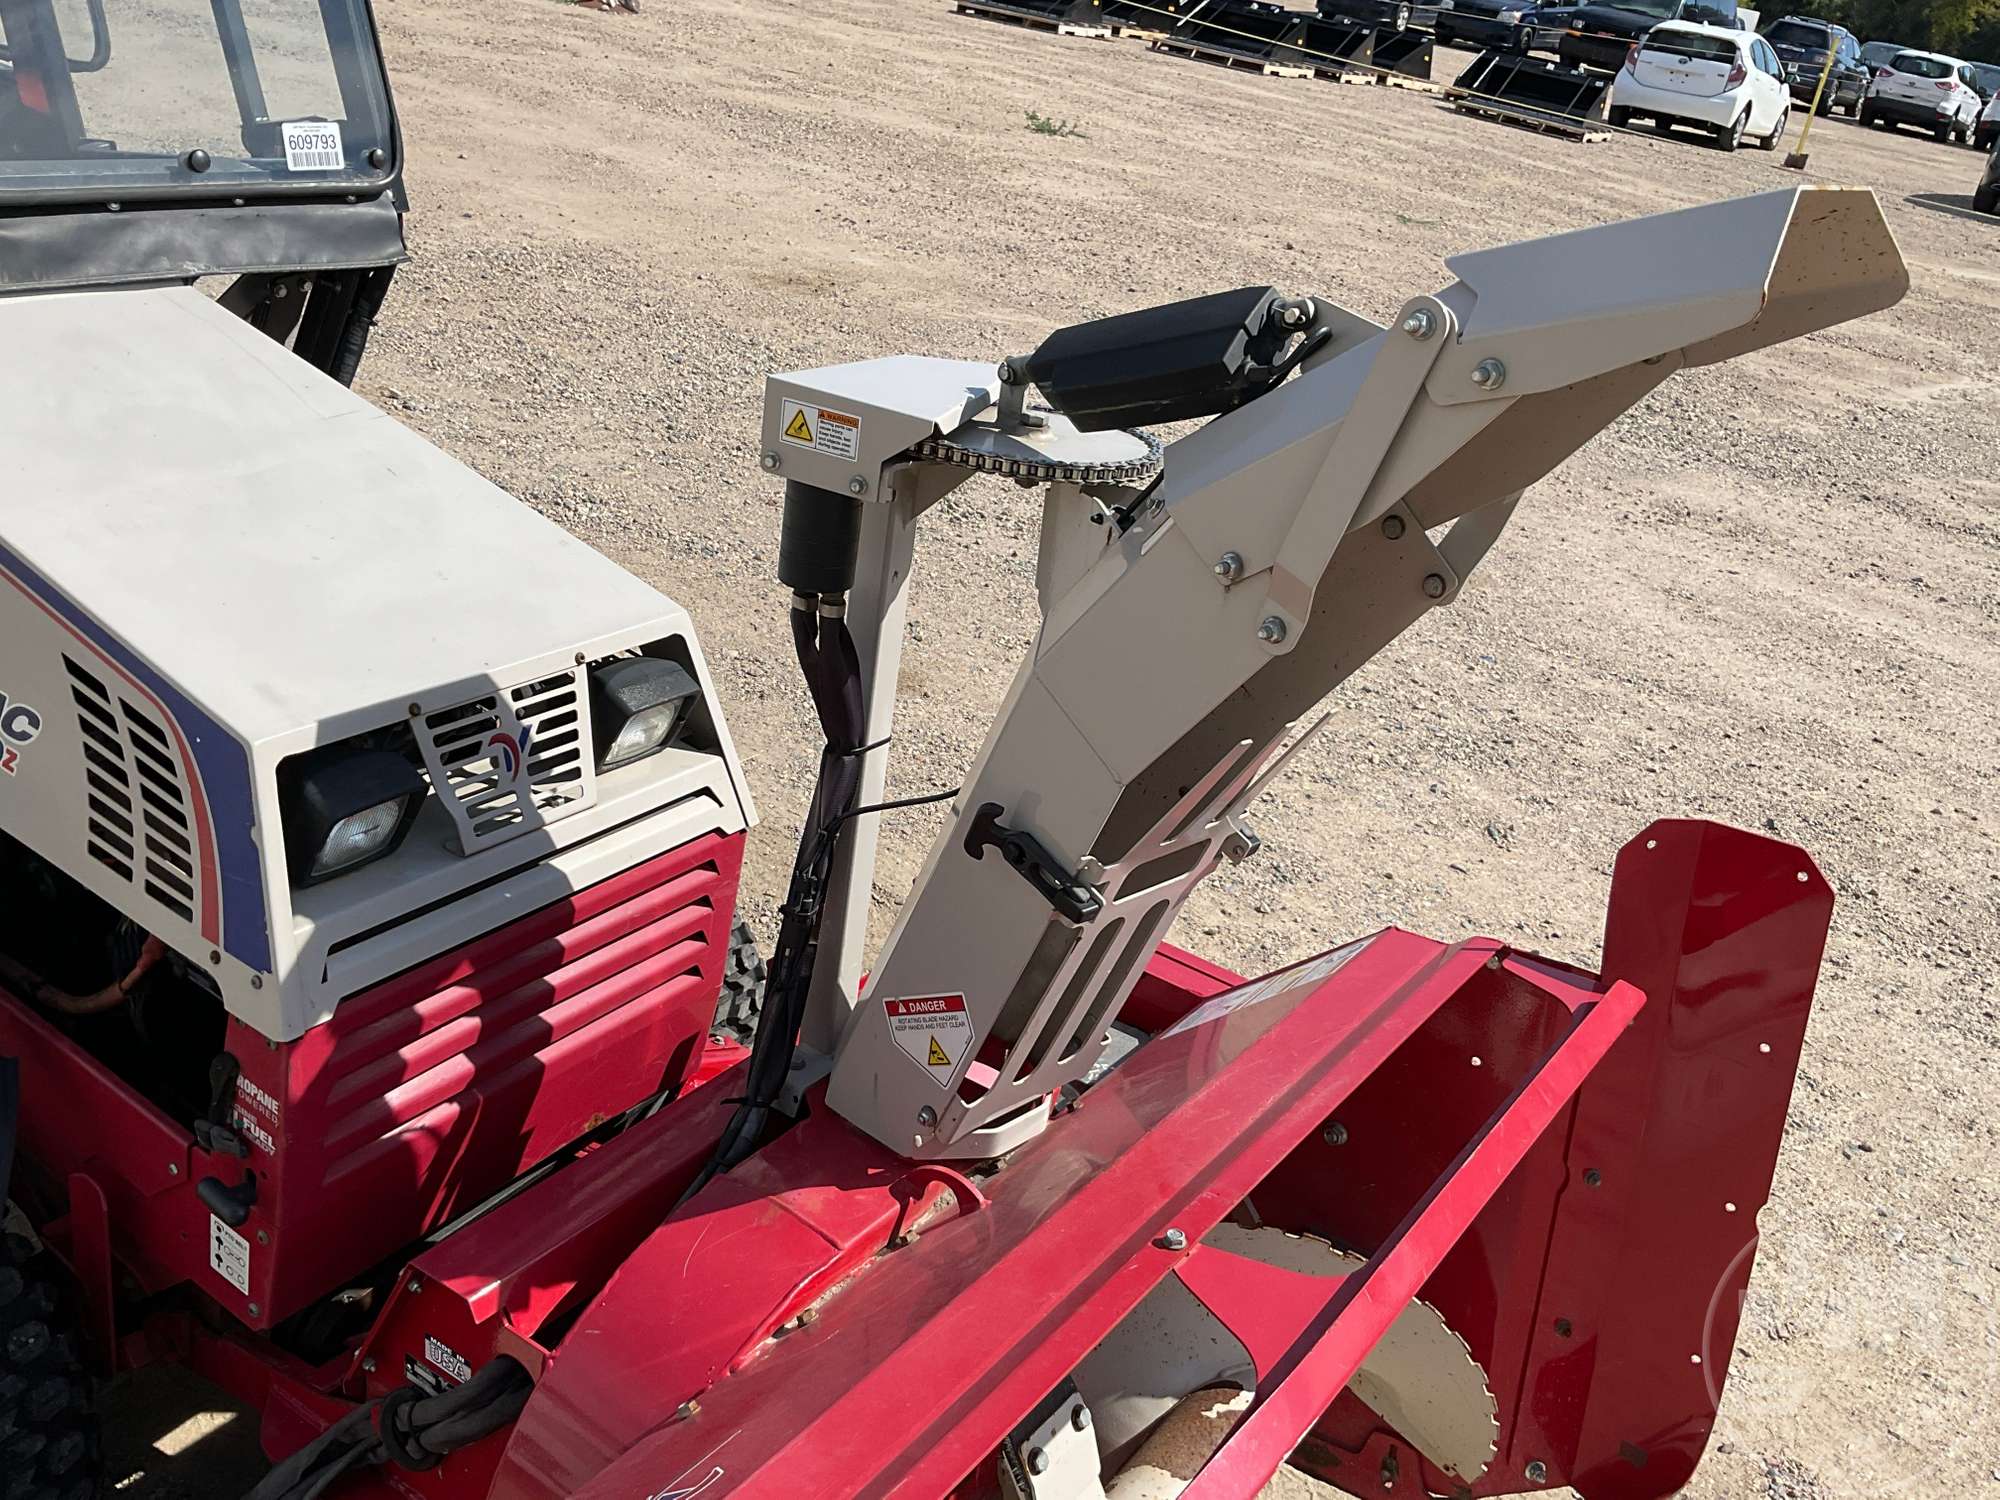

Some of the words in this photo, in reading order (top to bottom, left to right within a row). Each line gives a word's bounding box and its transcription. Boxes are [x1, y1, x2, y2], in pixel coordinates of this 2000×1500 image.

[288, 133, 337, 150] 609793
[908, 1000, 947, 1013] DANGER
[907, 1023, 925, 1031] HANDS
[925, 1022, 936, 1030] AND
[935, 1021, 949, 1029] FEET
[922, 1015, 938, 1023] BLADE
[938, 1014, 959, 1022] HAZARD
[236, 1074, 280, 1115] ROPANE
[430, 1336, 453, 1355] MADE
[456, 1354, 465, 1364] IN
[430, 1344, 467, 1382] USA
